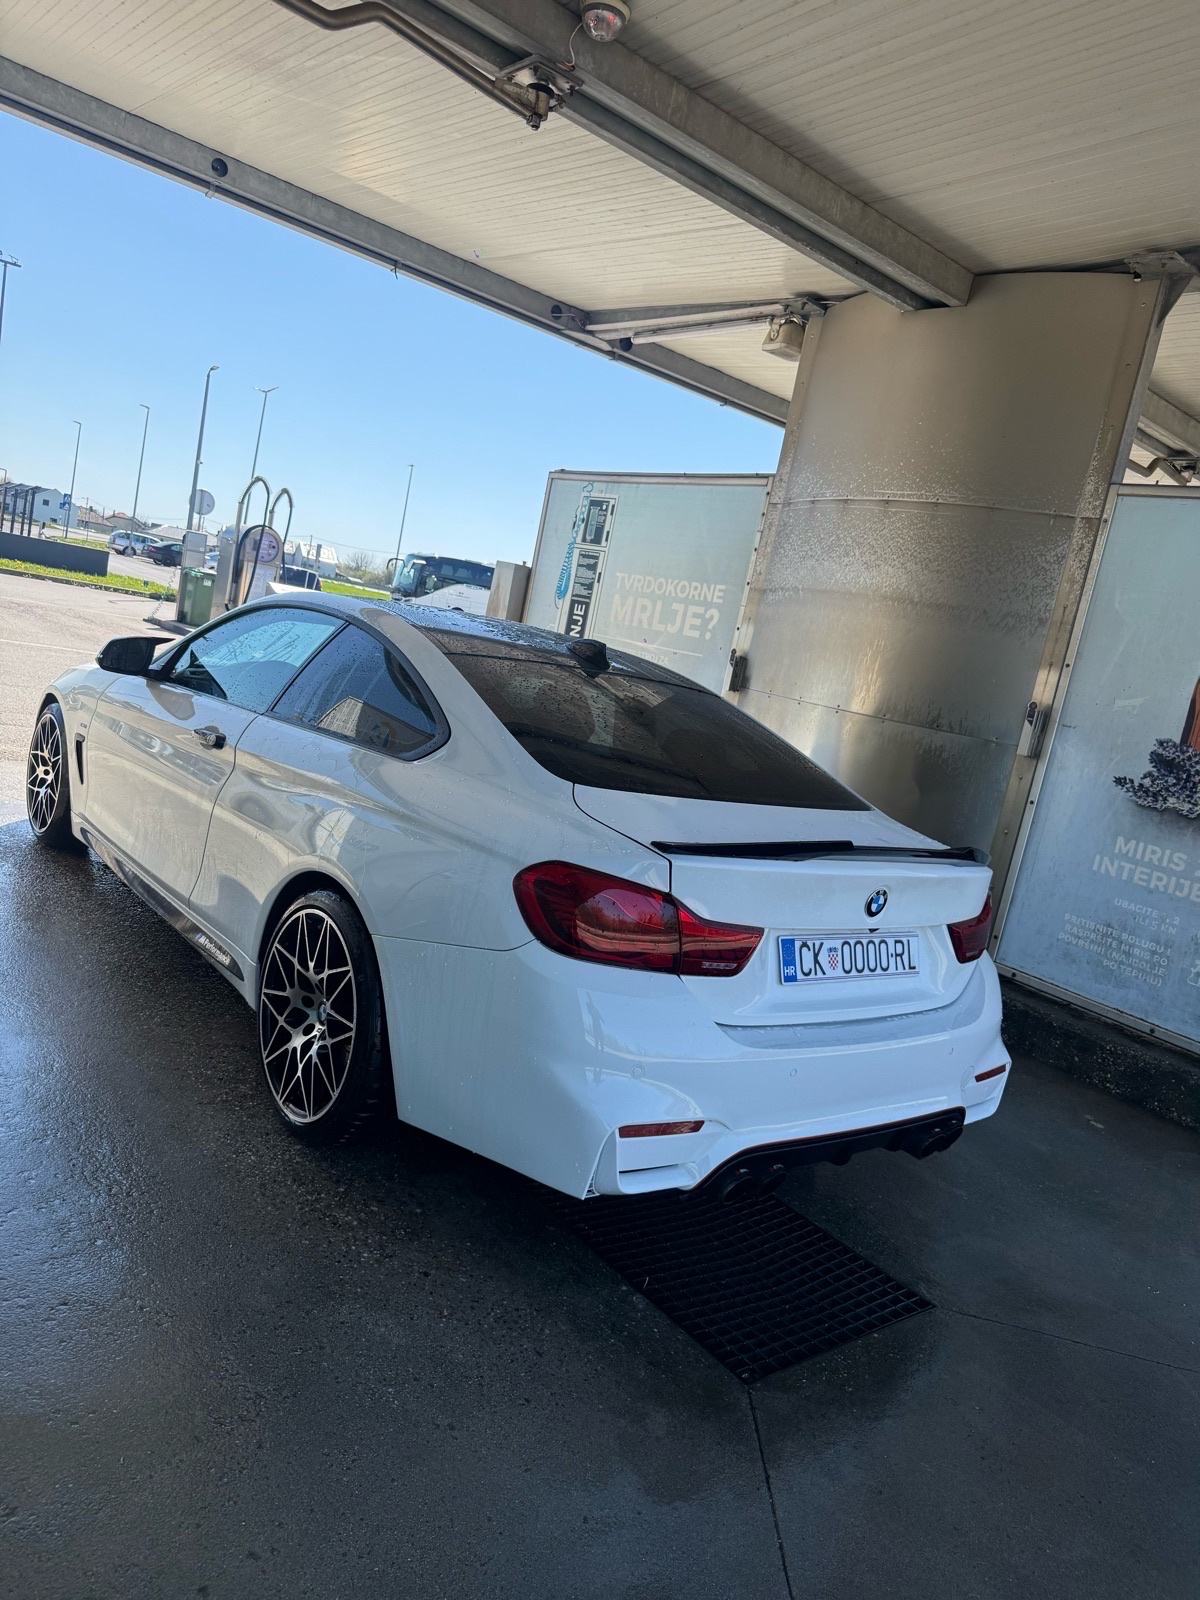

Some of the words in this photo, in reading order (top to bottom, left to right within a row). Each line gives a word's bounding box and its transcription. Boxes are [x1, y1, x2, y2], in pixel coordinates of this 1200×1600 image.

[616, 572, 727, 604] TVRDOKORNE
[569, 603, 586, 637] NJE
[610, 593, 721, 641] MRLJE?
[1114, 836, 1188, 872] MIRIS
[1114, 897, 1159, 918] UBACITE
[1120, 943, 1151, 960] MIRIS
[1121, 933, 1164, 953] POLUGU
[784, 965, 796, 977] HR
